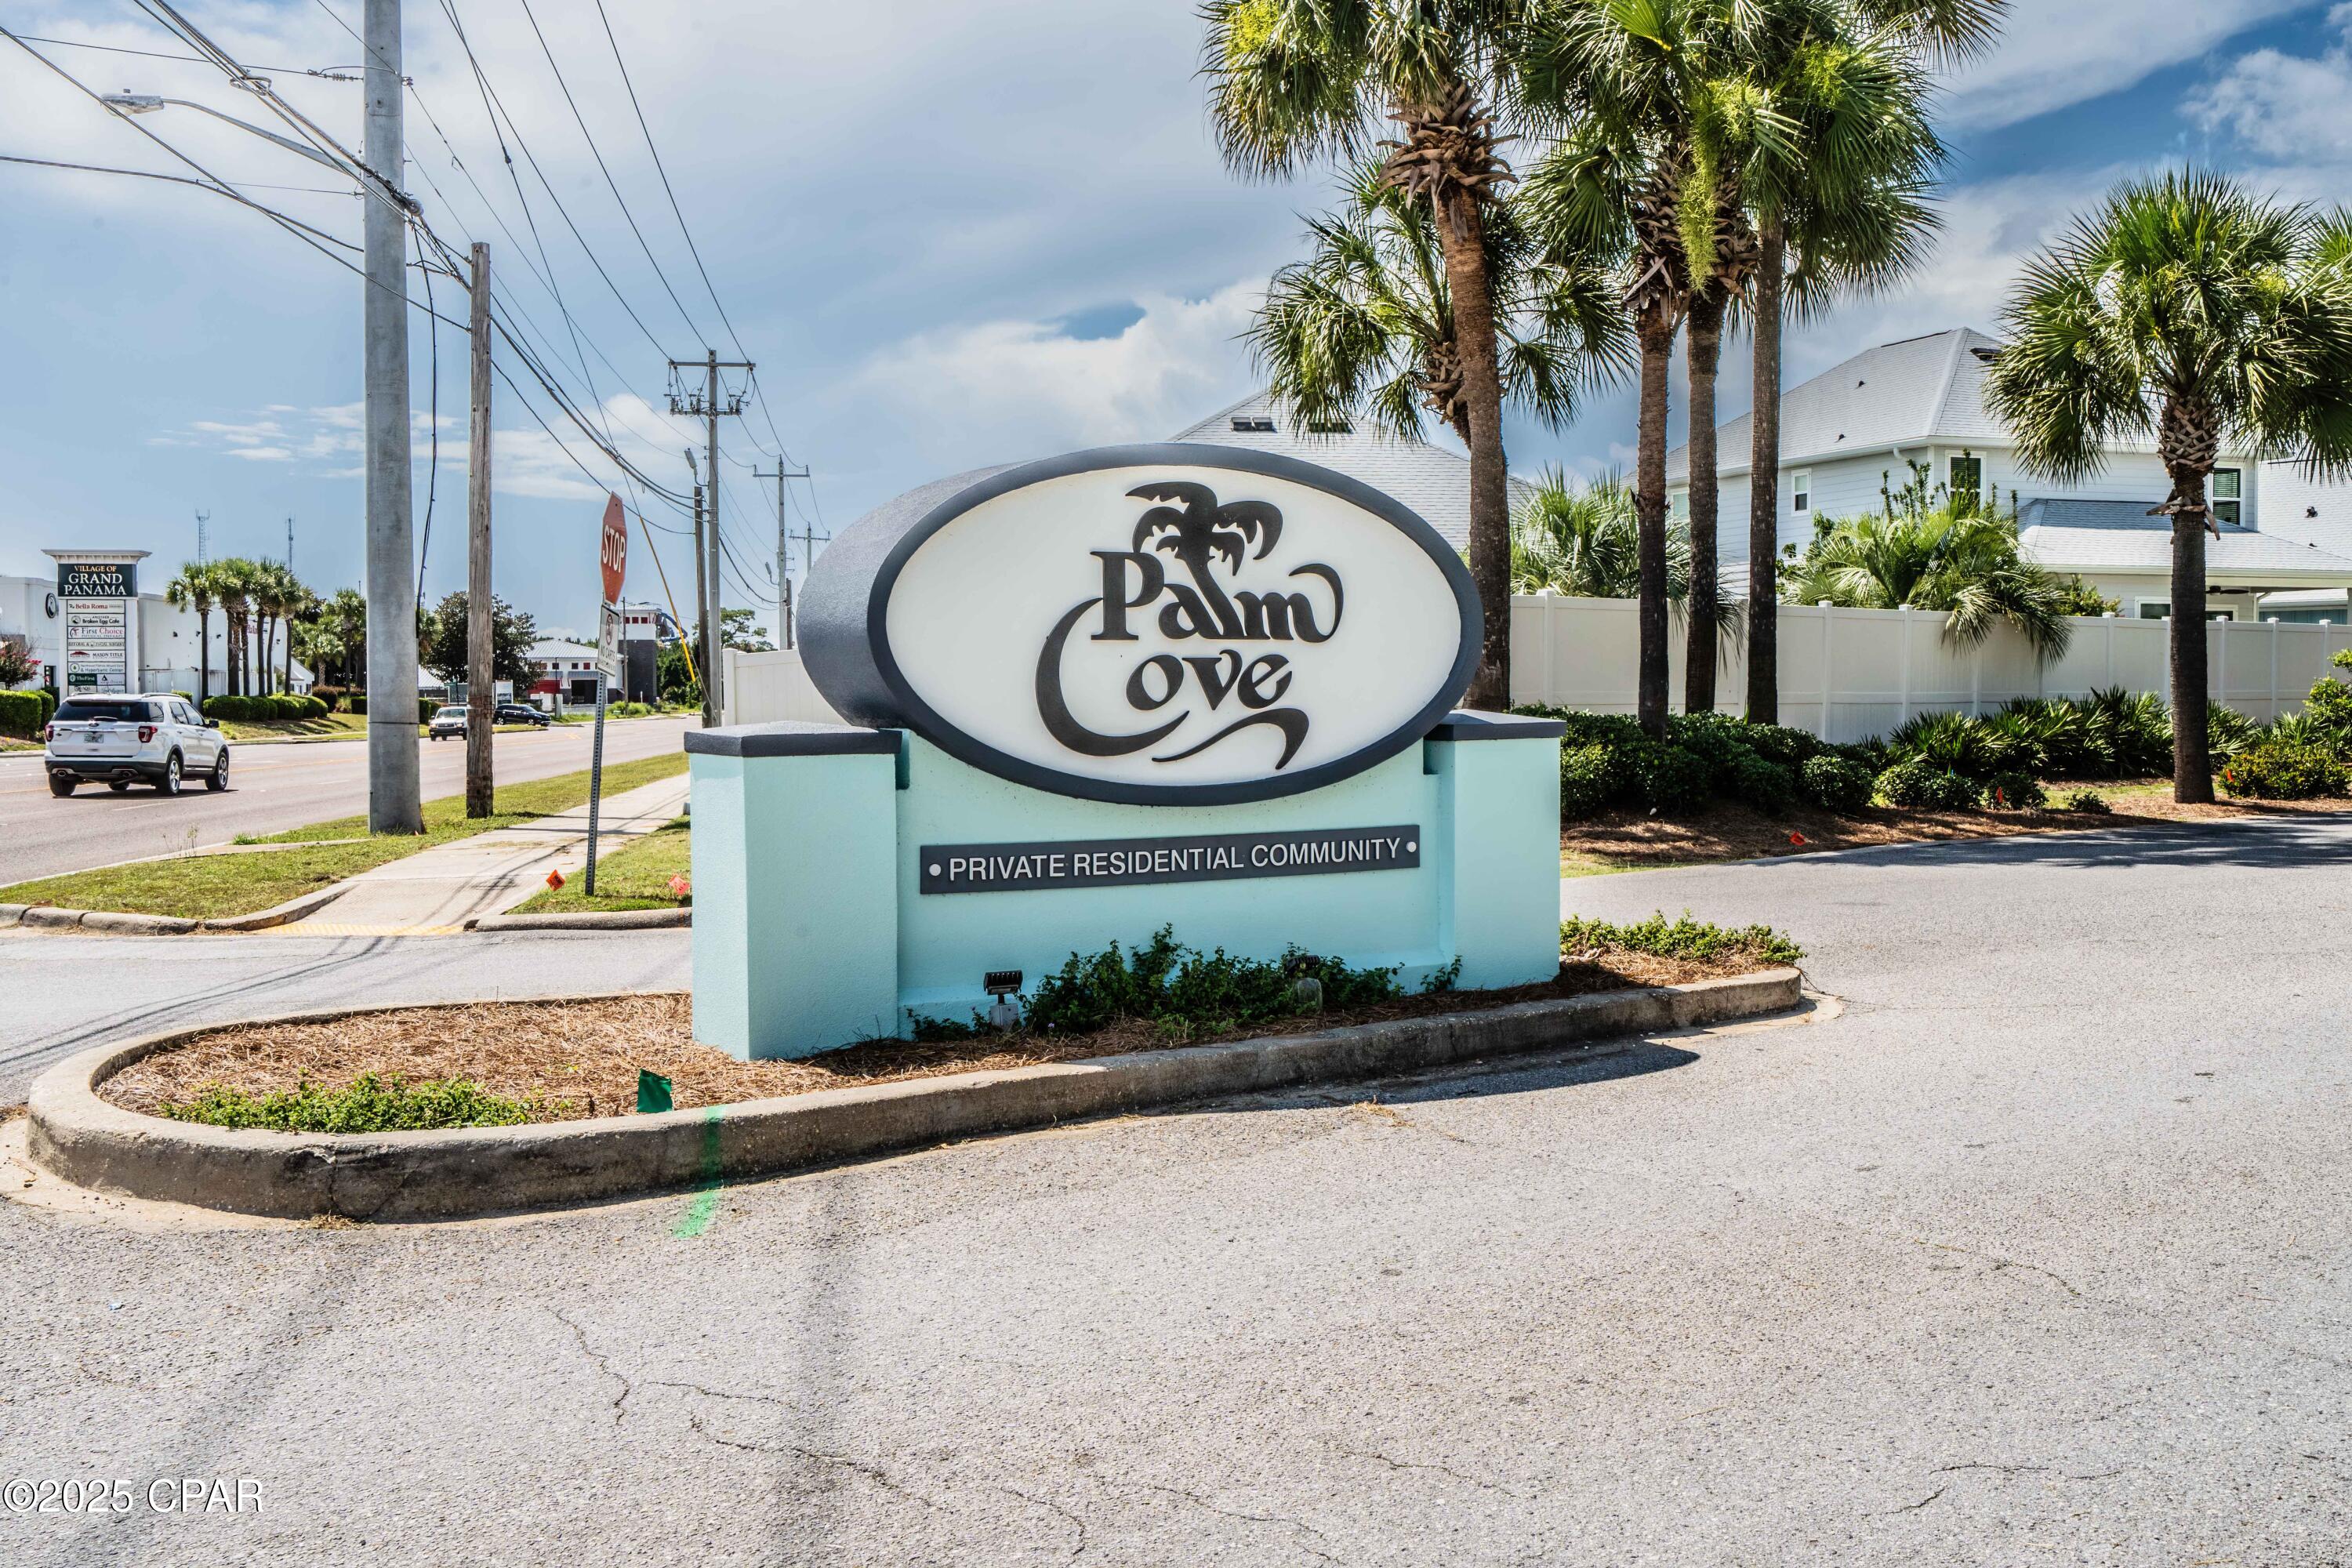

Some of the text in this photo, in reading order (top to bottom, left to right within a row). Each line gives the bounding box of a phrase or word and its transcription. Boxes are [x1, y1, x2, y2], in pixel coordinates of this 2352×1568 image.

[602, 524, 626, 573] STOP
[64, 584, 127, 595] PANAMA
[68, 573, 123, 584] GRAND
[1090, 550, 1344, 643] Palm
[1036, 597, 1294, 757] Cove
[949, 837, 1400, 881] PRIVATE RESIDENTIAL COMMUNITY
